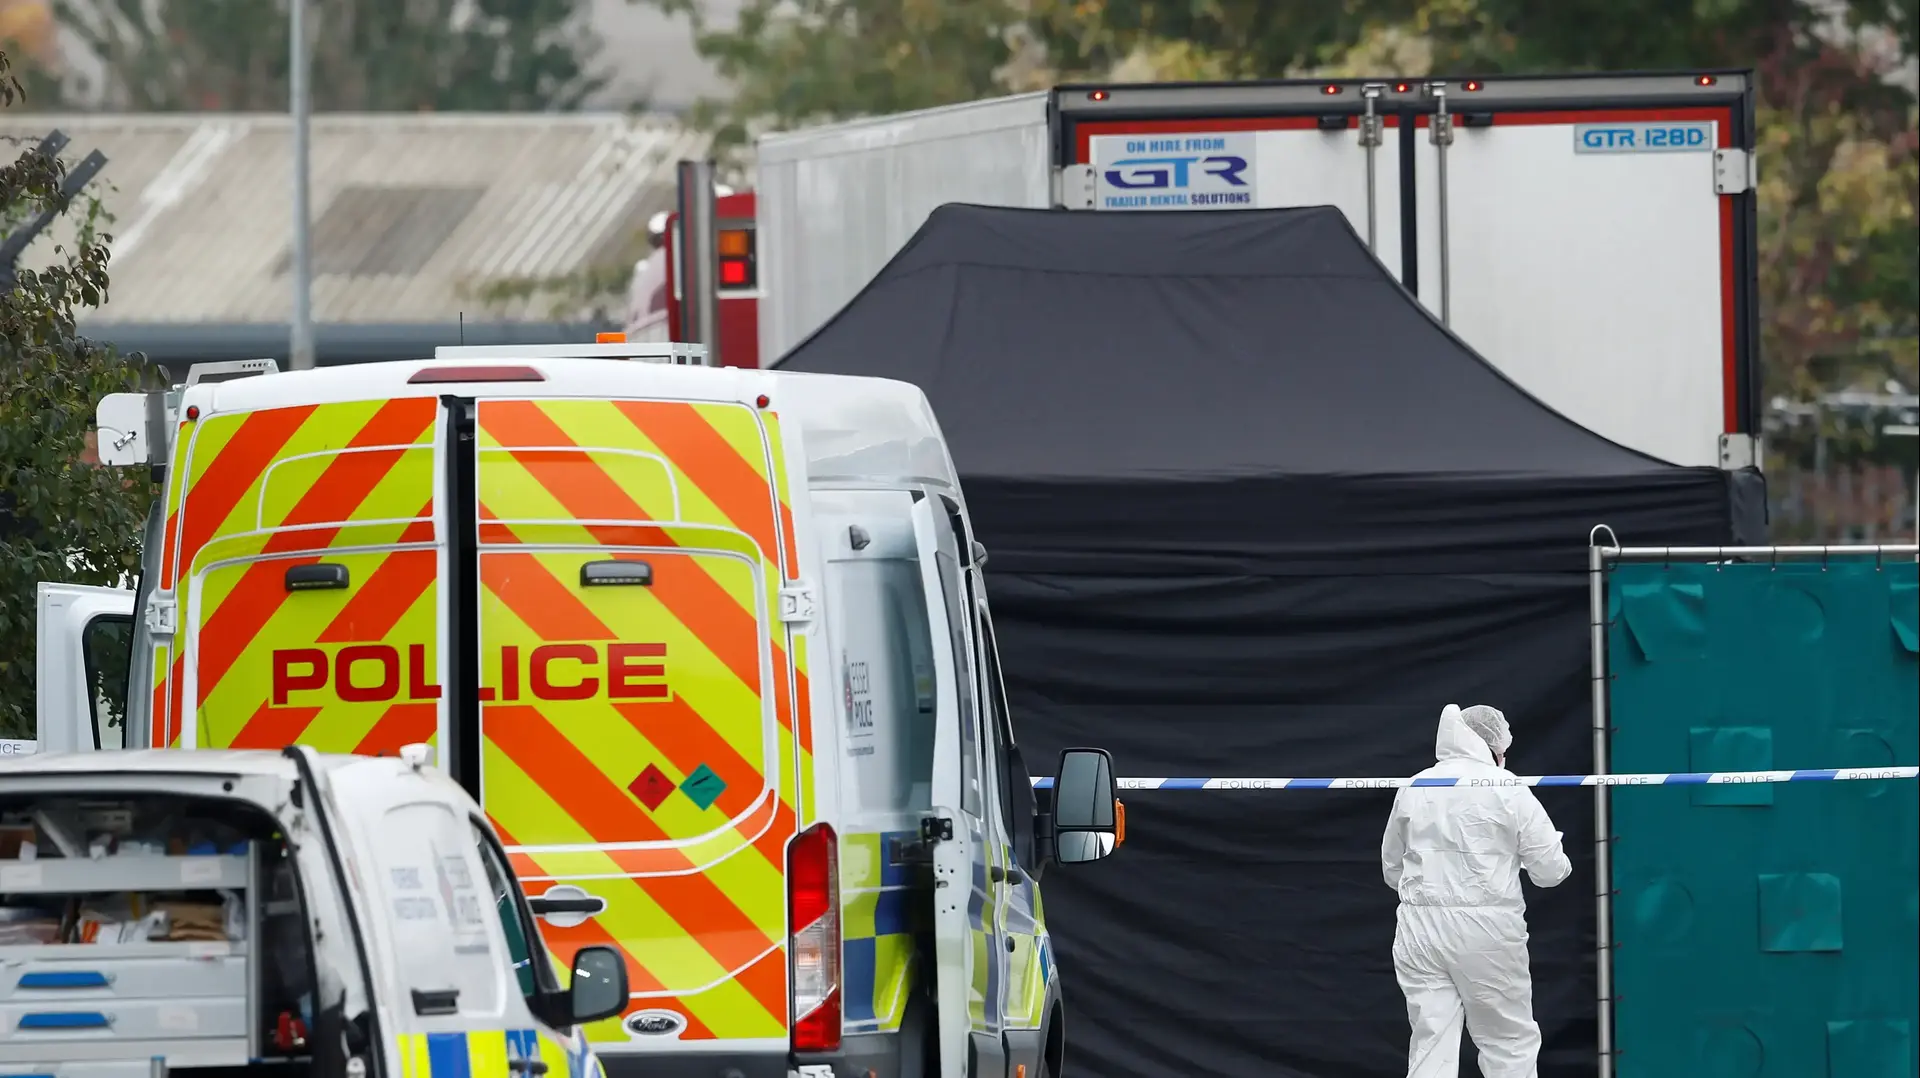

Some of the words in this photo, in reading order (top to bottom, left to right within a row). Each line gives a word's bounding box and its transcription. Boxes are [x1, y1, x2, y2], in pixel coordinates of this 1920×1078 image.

[1583, 129, 1635, 147] GTR
[1645, 128, 1704, 147] 128D
[1126, 141, 1146, 153] ON
[1149, 139, 1180, 152] HIRE
[1185, 138, 1225, 151] FROM
[1104, 156, 1249, 189] GTR
[1105, 196, 1148, 208] TRAILER
[1150, 195, 1189, 206] RENTAL
[1191, 193, 1251, 205] SOLUTIONS
[273, 643, 668, 704] POLICE
[0, 743, 21, 754] ICE
[1220, 780, 1272, 790] POLICE
[1345, 780, 1398, 789] POLICE
